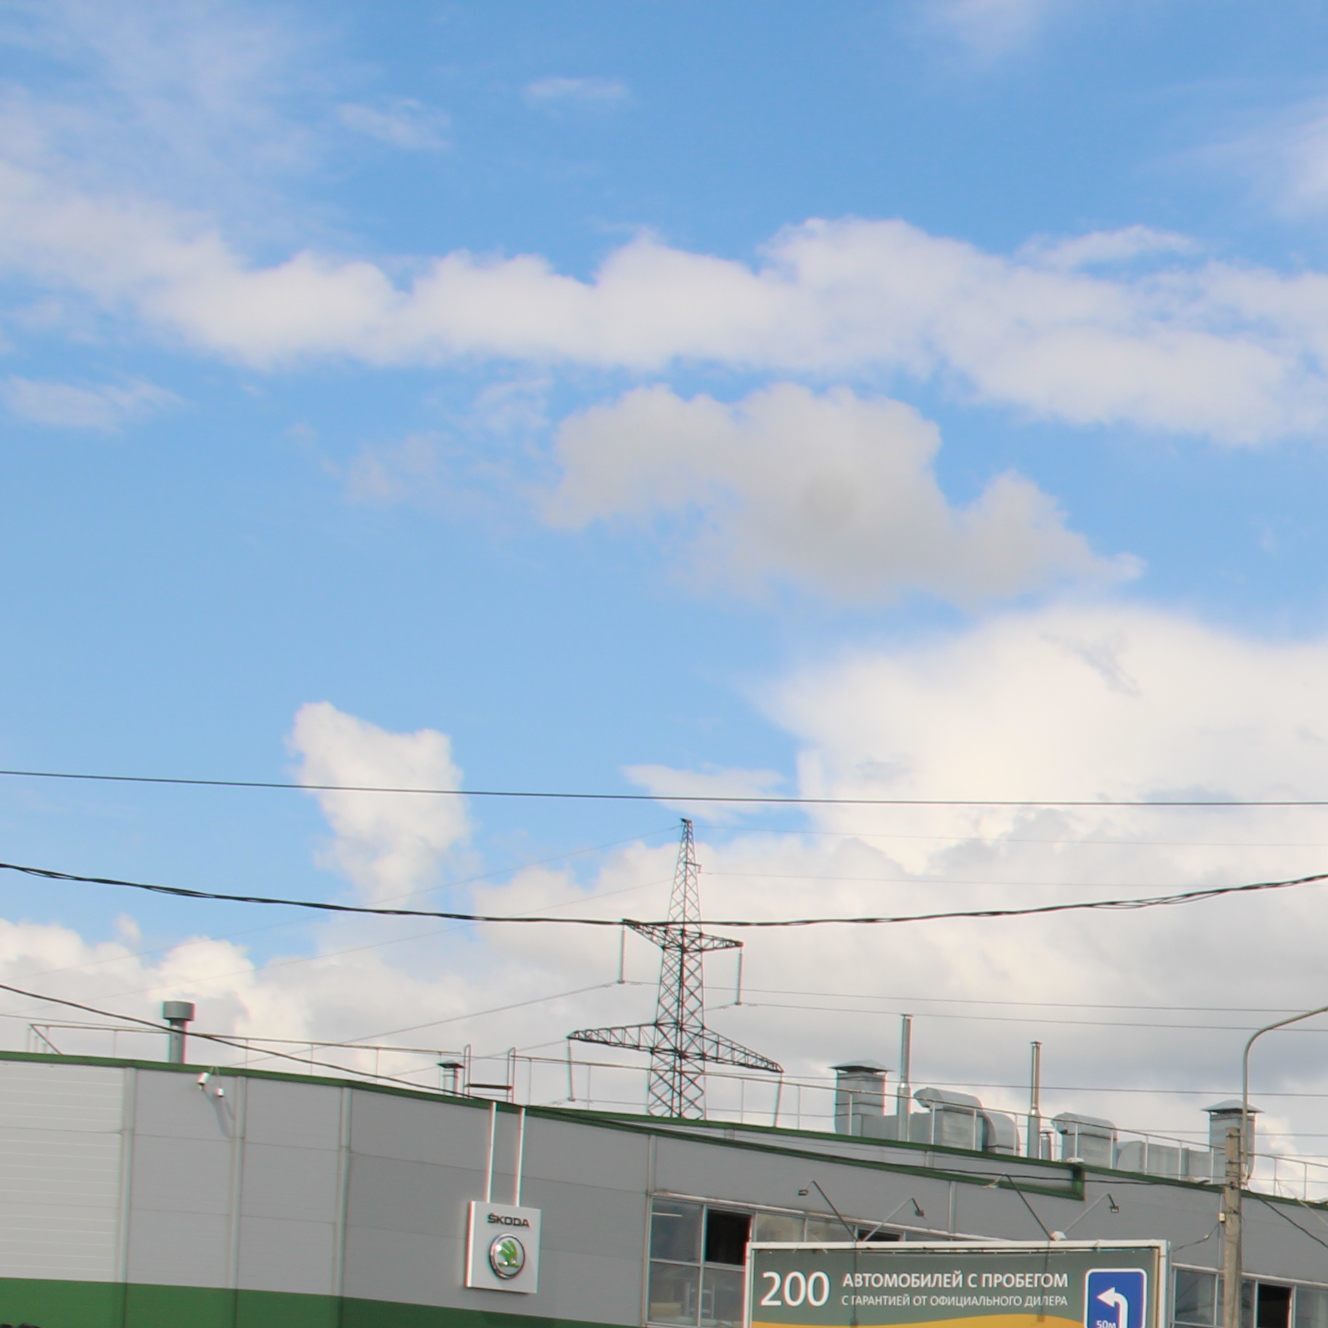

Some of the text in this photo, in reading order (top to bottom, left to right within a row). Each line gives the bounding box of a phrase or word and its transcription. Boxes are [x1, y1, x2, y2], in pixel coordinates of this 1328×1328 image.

[842, 1270, 1069, 1288] АВТОМОБИЛЕЙ С ПРОБЕГОМ
[760, 1271, 831, 1307] 200
[841, 1293, 1069, 1307] С ГАРАНТИЕЙ ОТ ОФИЦИАЛЬНОГО ДИЛЕРА
